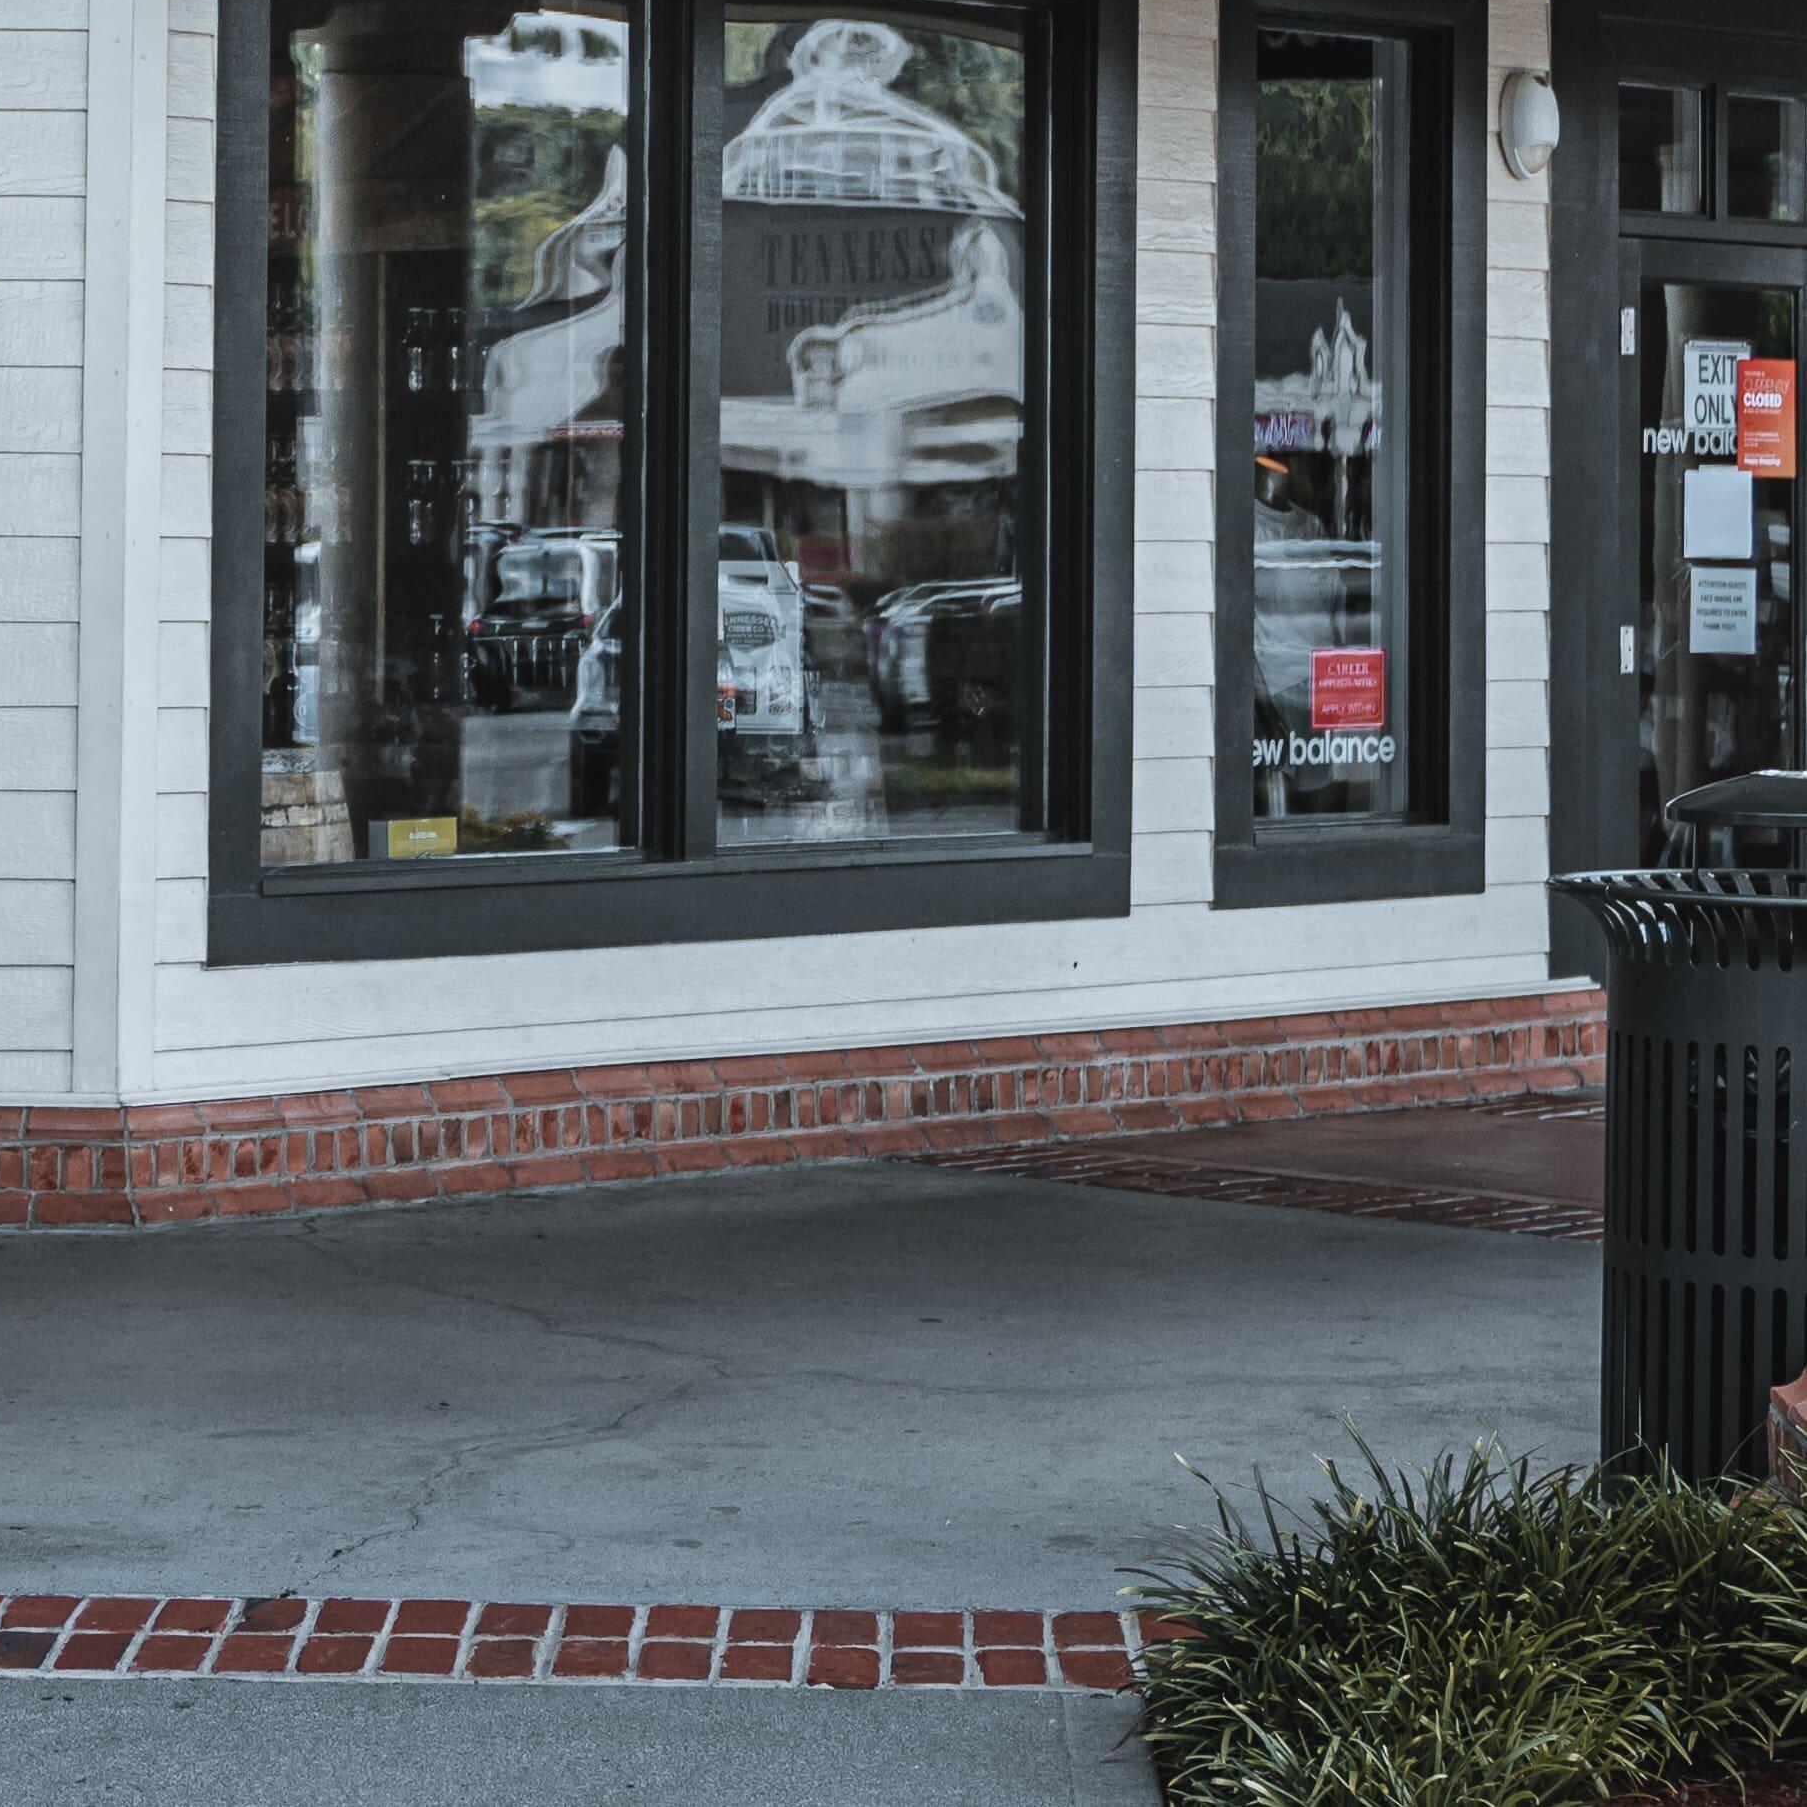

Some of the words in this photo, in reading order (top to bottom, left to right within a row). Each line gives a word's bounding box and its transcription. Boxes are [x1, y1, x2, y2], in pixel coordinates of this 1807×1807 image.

[1698, 354, 1737, 385] EXIT
[1643, 426, 1688, 455] new
[1289, 730, 1396, 766] balance
